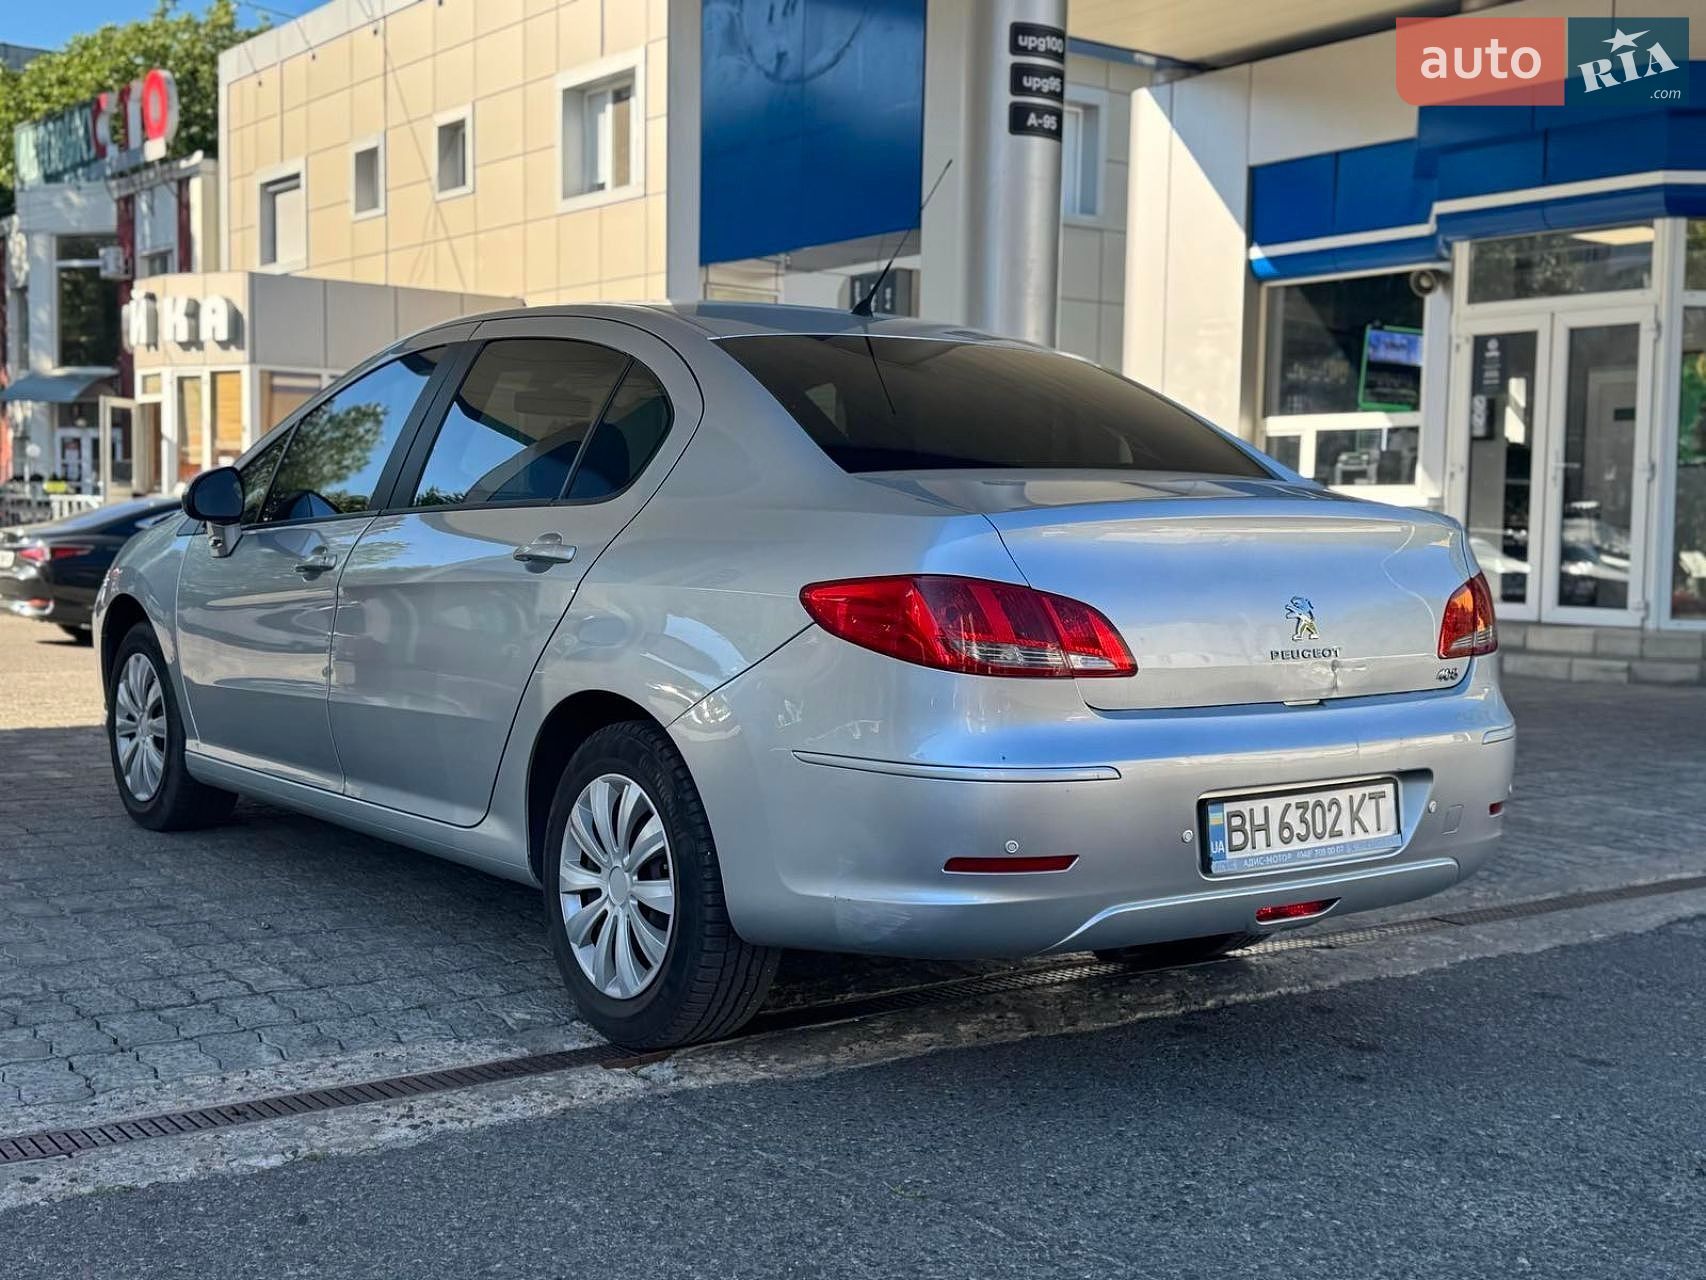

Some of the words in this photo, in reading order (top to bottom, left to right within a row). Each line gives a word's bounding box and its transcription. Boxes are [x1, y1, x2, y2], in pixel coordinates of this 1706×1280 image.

[1018, 35, 1064, 53] upg100
[1022, 75, 1062, 92] upg95
[1026, 112, 1057, 130] A-95
[121, 288, 230, 350] ЙКА
[1270, 647, 1341, 660] PEUGEOT
[1278, 797, 1343, 845] 6302
[1210, 841, 1225, 854] UA
